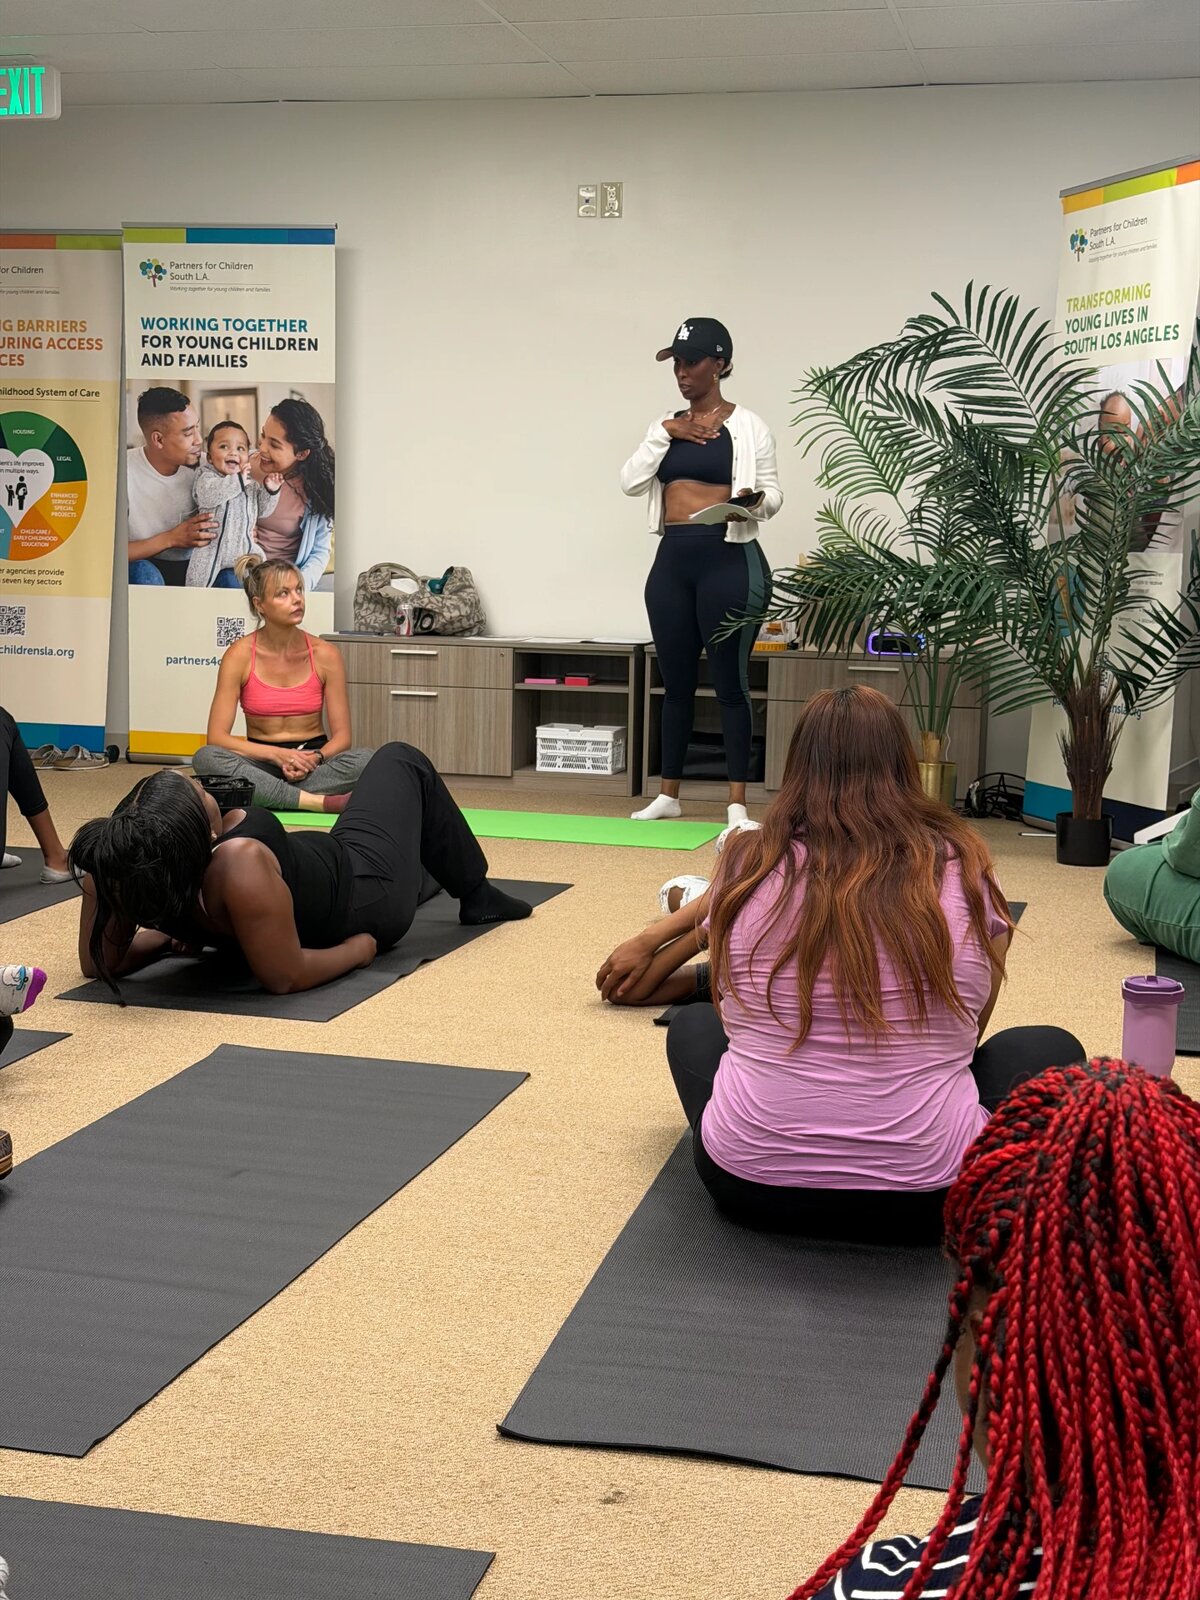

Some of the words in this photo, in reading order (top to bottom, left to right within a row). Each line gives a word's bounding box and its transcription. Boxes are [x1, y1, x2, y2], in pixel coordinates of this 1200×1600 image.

[1090, 225, 1112, 238] Partners
[1113, 223, 1122, 231] for
[1123, 216, 1148, 229] Children
[1089, 240, 1105, 251] South
[11, 266, 44, 274] Children
[169, 261, 203, 270] Partners
[205, 261, 217, 270] for
[218, 261, 254, 270] Children
[169, 272, 194, 281] South
[195, 272, 210, 281] L.A.
[1067, 282, 1151, 313] TRANSFORMING
[17, 319, 87, 333] BARRIERS
[140, 316, 219, 331] WORKING
[222, 318, 308, 333] TOGETHER
[1065, 313, 1102, 334] YOUNG
[1104, 307, 1135, 328] LIVES
[1137, 305, 1149, 323] IN
[46, 337, 104, 351] ACCESS
[141, 335, 172, 348] FOR
[176, 336, 234, 350] YOUNG
[237, 337, 319, 351] CHILDREN
[1064, 335, 1097, 356] SOUTH
[1101, 331, 1122, 348] LOS
[1124, 324, 1180, 347] ANGELES
[141, 353, 175, 367] AND
[178, 353, 248, 368] FAMILIES
[36, 387, 67, 398] System
[69, 388, 78, 397] of
[79, 388, 100, 398] Care
[6, 567, 37, 576] agencies
[37, 568, 65, 577] provide
[23, 577, 36, 586] key
[36, 578, 63, 586] sectors
